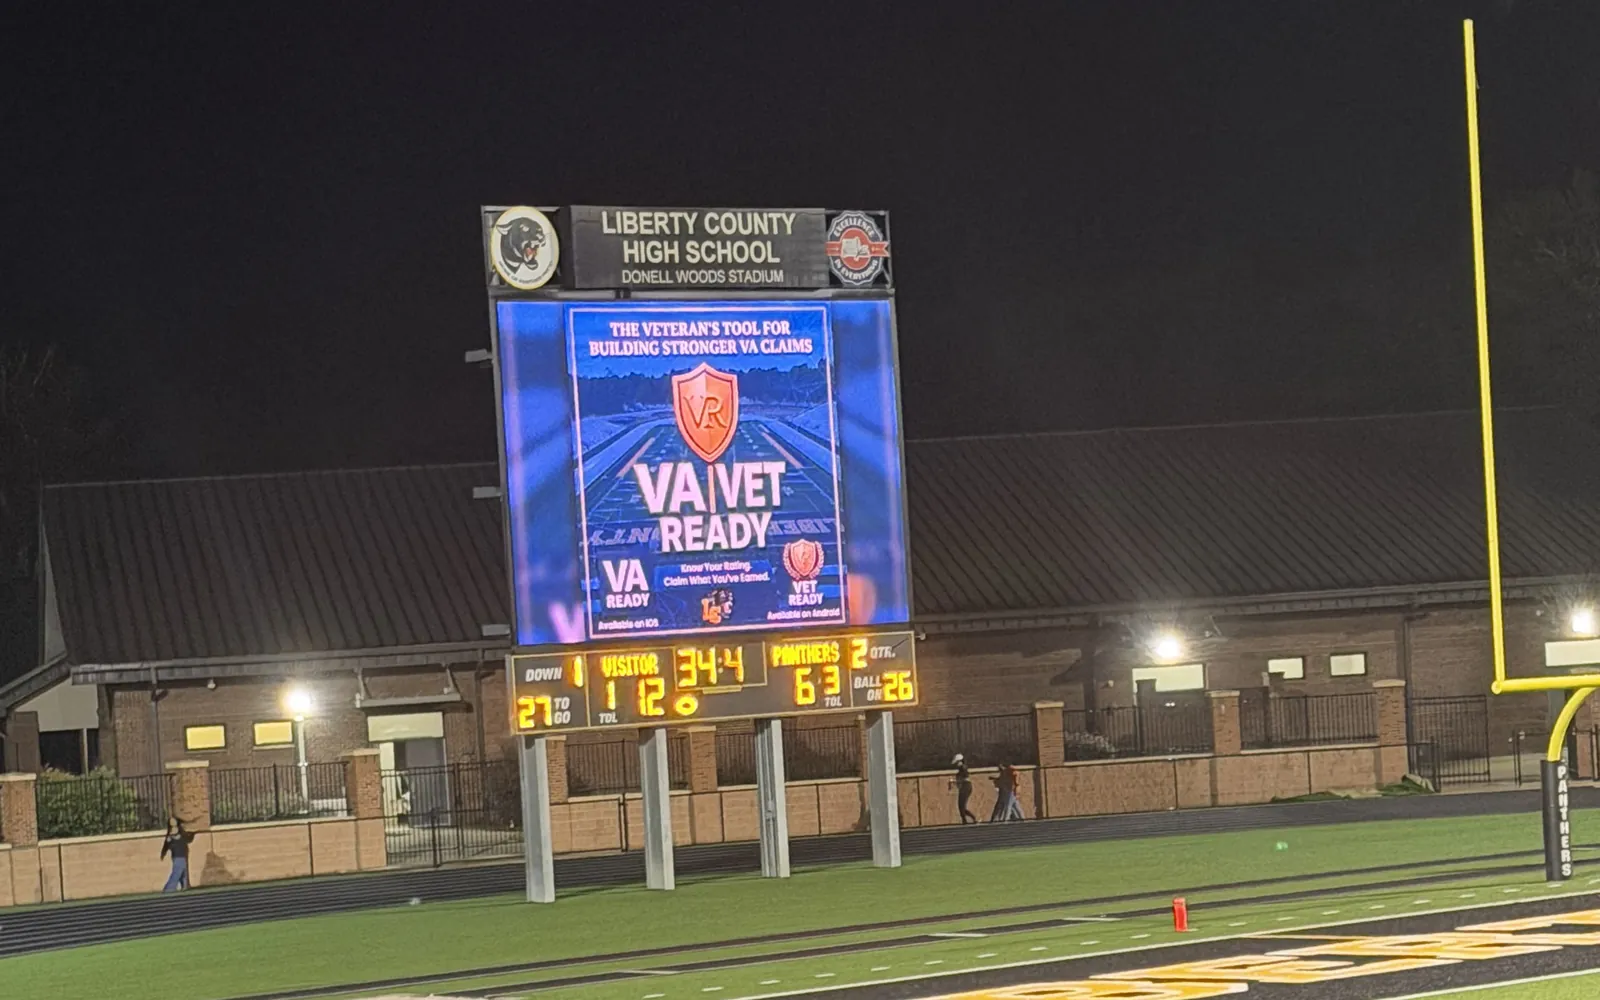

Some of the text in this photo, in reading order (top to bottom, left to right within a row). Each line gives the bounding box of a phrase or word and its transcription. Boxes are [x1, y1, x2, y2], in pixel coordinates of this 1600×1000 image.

[602, 211, 796, 235] LIBERTY COUNTY
[623, 240, 781, 264] HIGH SCHOOL
[622, 269, 784, 284] DONELL WOODS STADIUM
[610, 320, 791, 337] THE VETERAN'S TOOL FOR
[589, 338, 813, 357] BUILDING STRONGER VA CLAIMS
[633, 461, 786, 514] VA VET
[659, 512, 772, 553] READY
[602, 558, 649, 593] VA
[681, 563, 703, 573] Know
[704, 562, 723, 573] Your
[663, 576, 688, 587] Claim
[689, 575, 712, 586] What
[712, 574, 740, 585] You've
[792, 579, 818, 594] VET
[606, 593, 650, 609] READY
[788, 592, 824, 606] READY
[801, 610, 811, 618] on
[813, 607, 840, 617] Android
[634, 620, 644, 629] on
[772, 641, 840, 667] PANTHERS
[851, 638, 868, 669] 2
[573, 655, 584, 687] 1
[602, 652, 659, 677] VISITOR
[525, 667, 562, 682] DOWN
[823, 665, 840, 695] 3
[854, 676, 881, 689] BALL
[607, 679, 616, 710] 1
[795, 667, 815, 705] 6
[867, 689, 882, 701] ON
[883, 671, 914, 701] 26
[554, 697, 570, 709] TO
[638, 677, 665, 716] 12
[824, 697, 842, 707] TOL
[517, 695, 552, 728] 27
[554, 711, 571, 724] GO
[599, 712, 618, 724] TOL
[1557, 765, 1571, 876] PANTHERS
